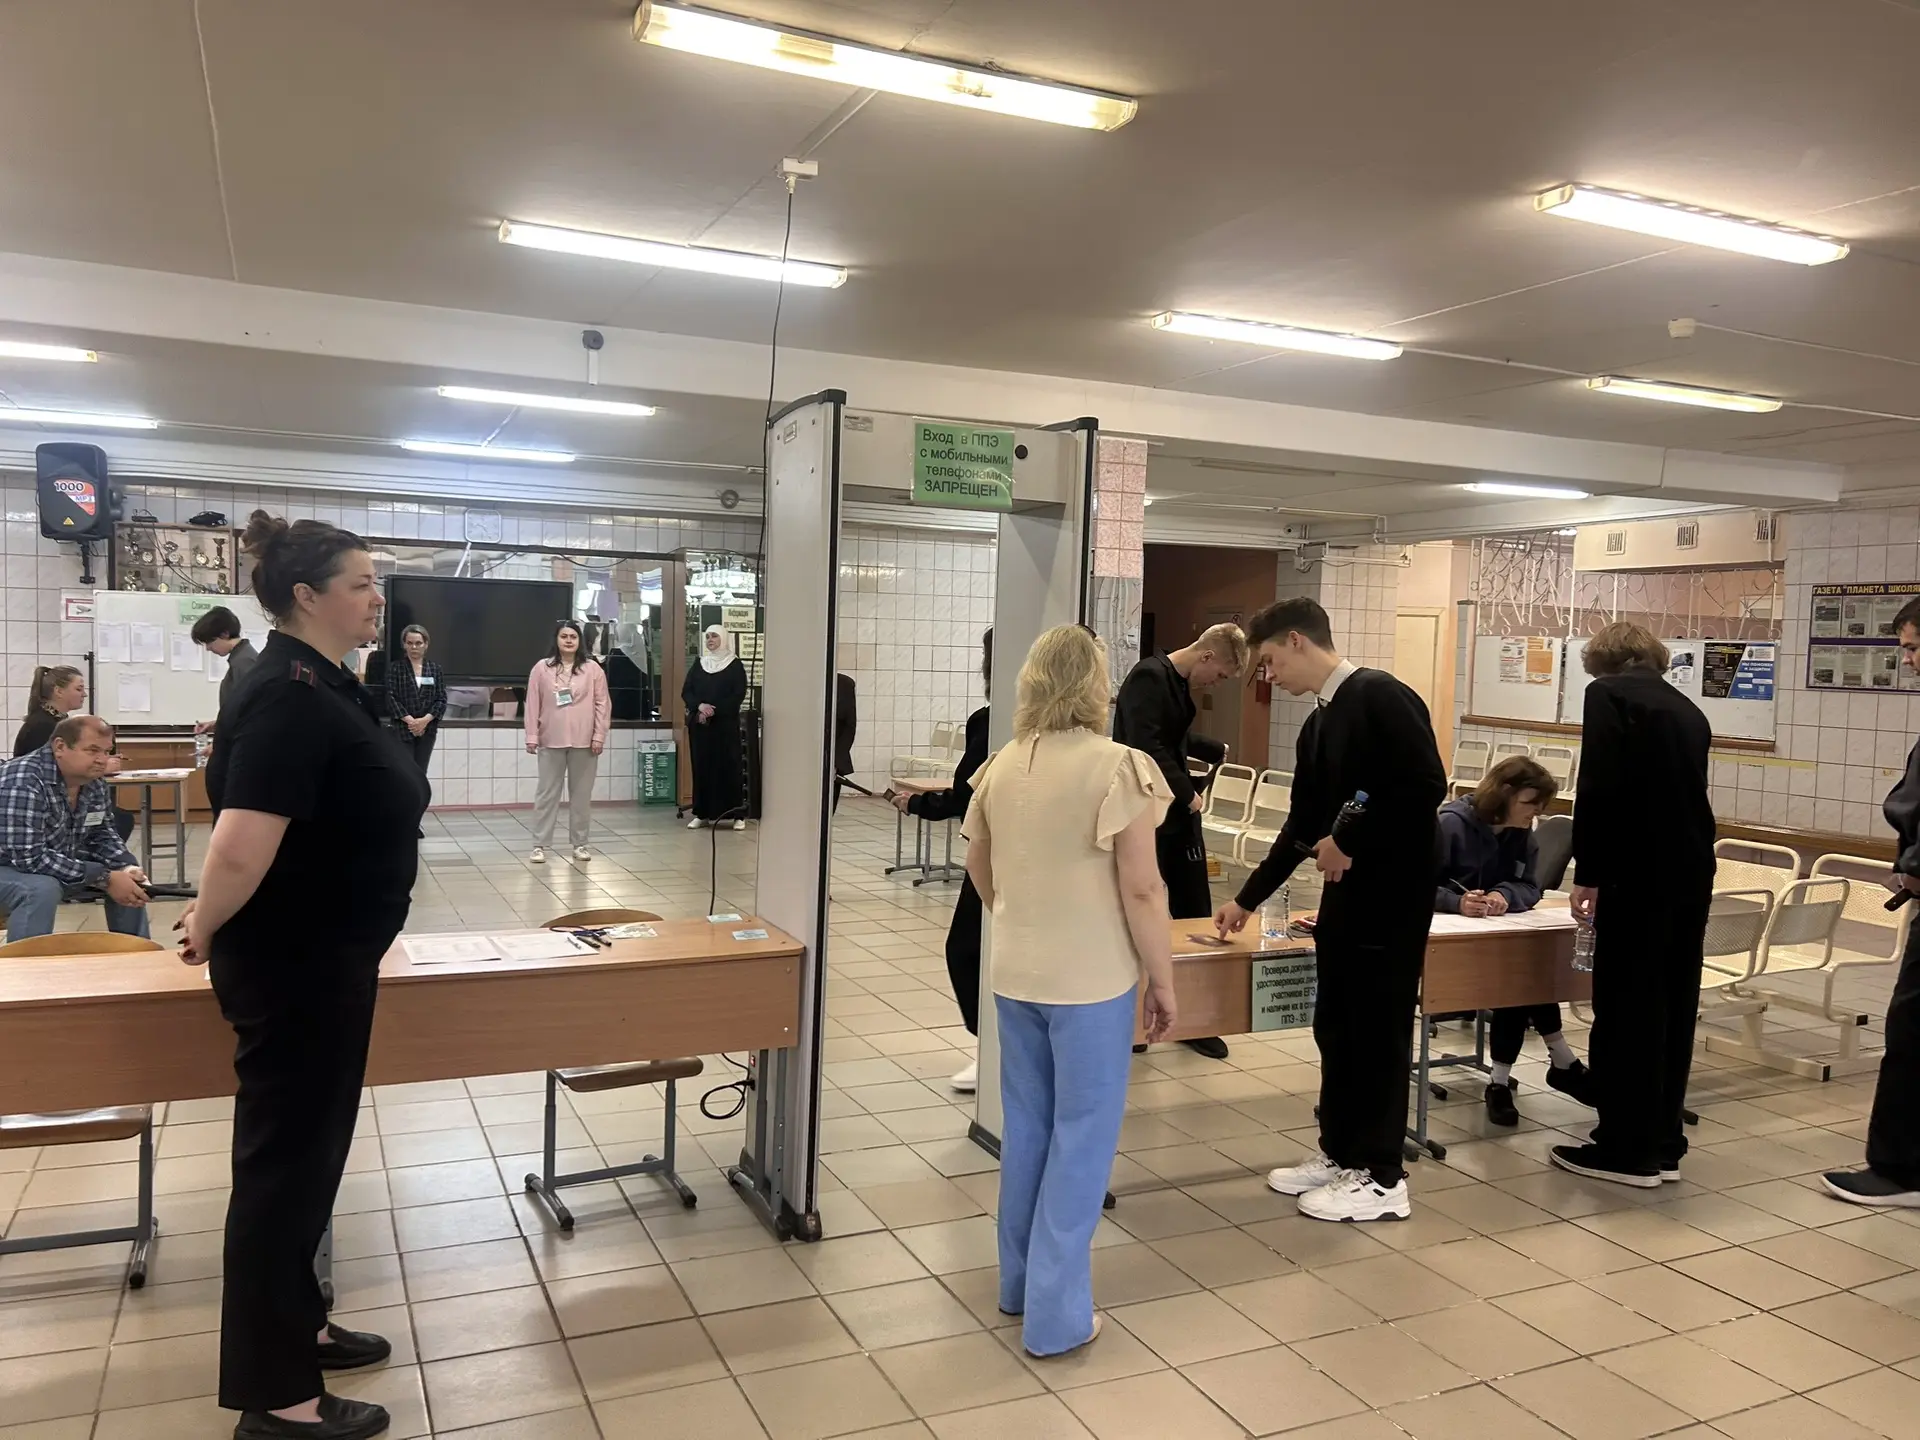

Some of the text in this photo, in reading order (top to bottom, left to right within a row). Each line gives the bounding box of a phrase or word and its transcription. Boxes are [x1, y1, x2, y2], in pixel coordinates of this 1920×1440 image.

[923, 428, 999, 448] Вход в ППЭ
[920, 448, 1008, 465] с мобильными
[926, 465, 1002, 480] телефонами
[54, 481, 84, 492] 1000
[925, 480, 998, 499] ЗАПРЕЩЕН
[1812, 586, 1842, 595] ГАЗЕТА
[644, 753, 654, 797] БАТАРЕЙКИ
[1261, 965, 1289, 977] Проверка
[1271, 986, 1316, 1002] участников ЕГЭ
